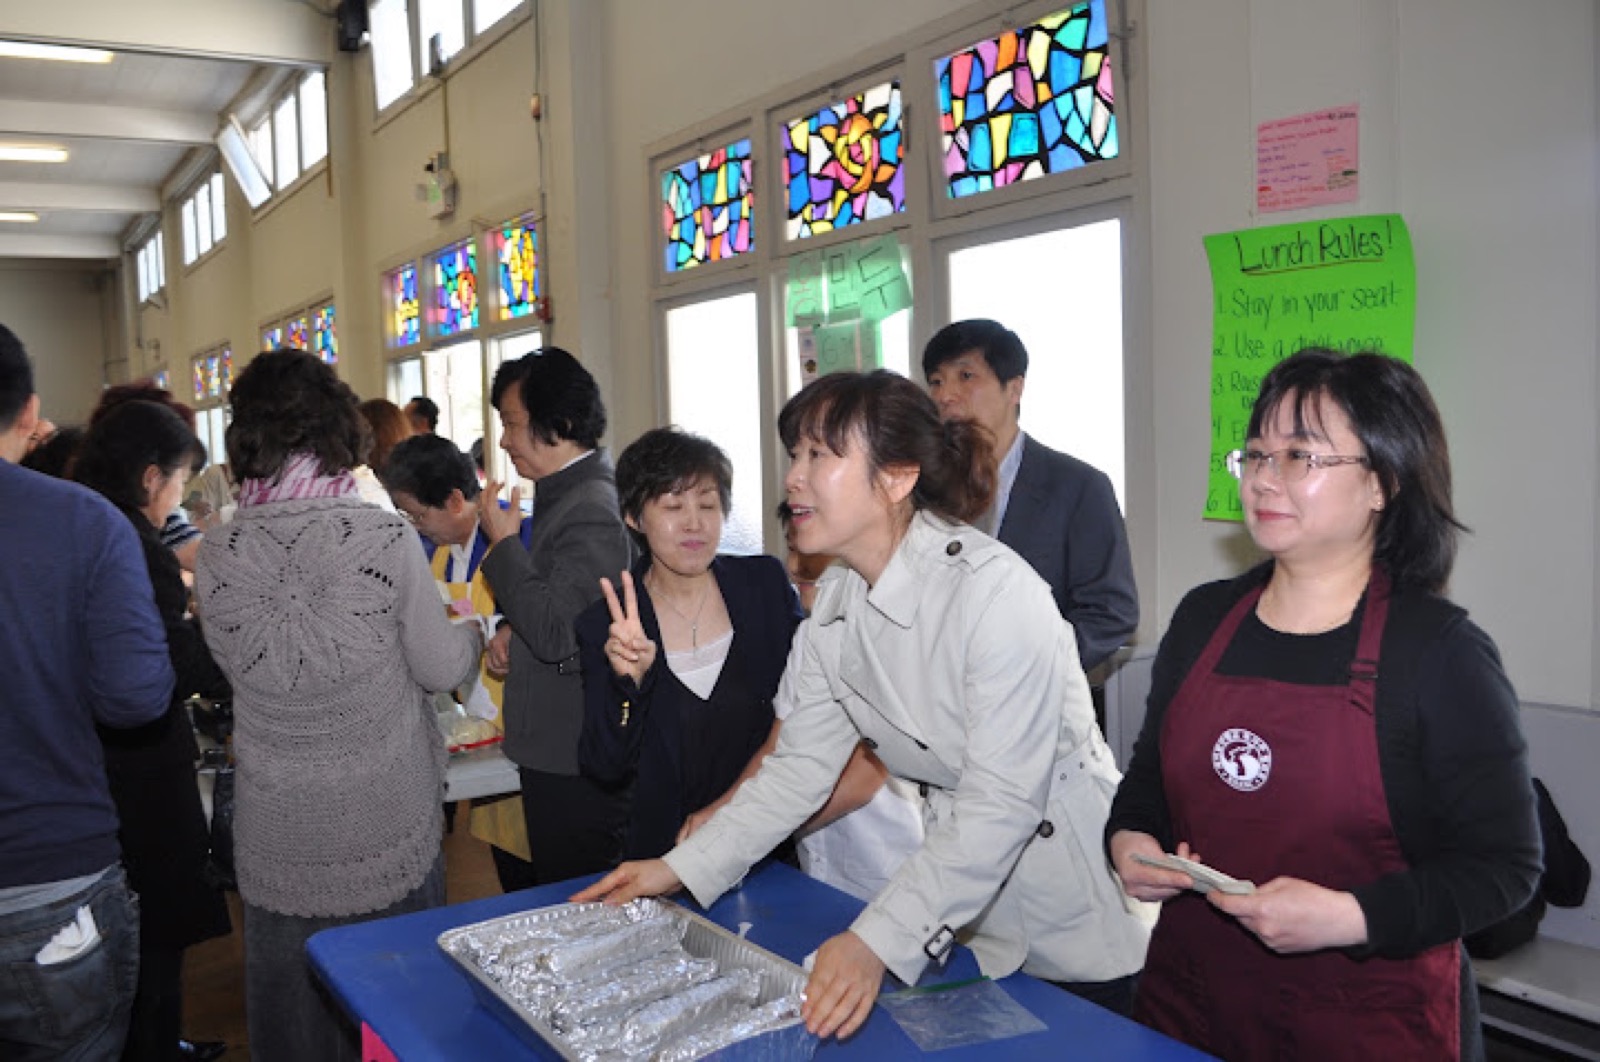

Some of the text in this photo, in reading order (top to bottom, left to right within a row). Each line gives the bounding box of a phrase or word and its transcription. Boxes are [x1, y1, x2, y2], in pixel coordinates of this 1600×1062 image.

[1233, 219, 1392, 272] Lunch Rules!
[1231, 288, 1274, 330] Stay
[1281, 294, 1299, 316] in
[1304, 289, 1345, 323] your
[1350, 279, 1400, 311] seat
[1234, 331, 1265, 359] Use
[1272, 339, 1283, 357] a
